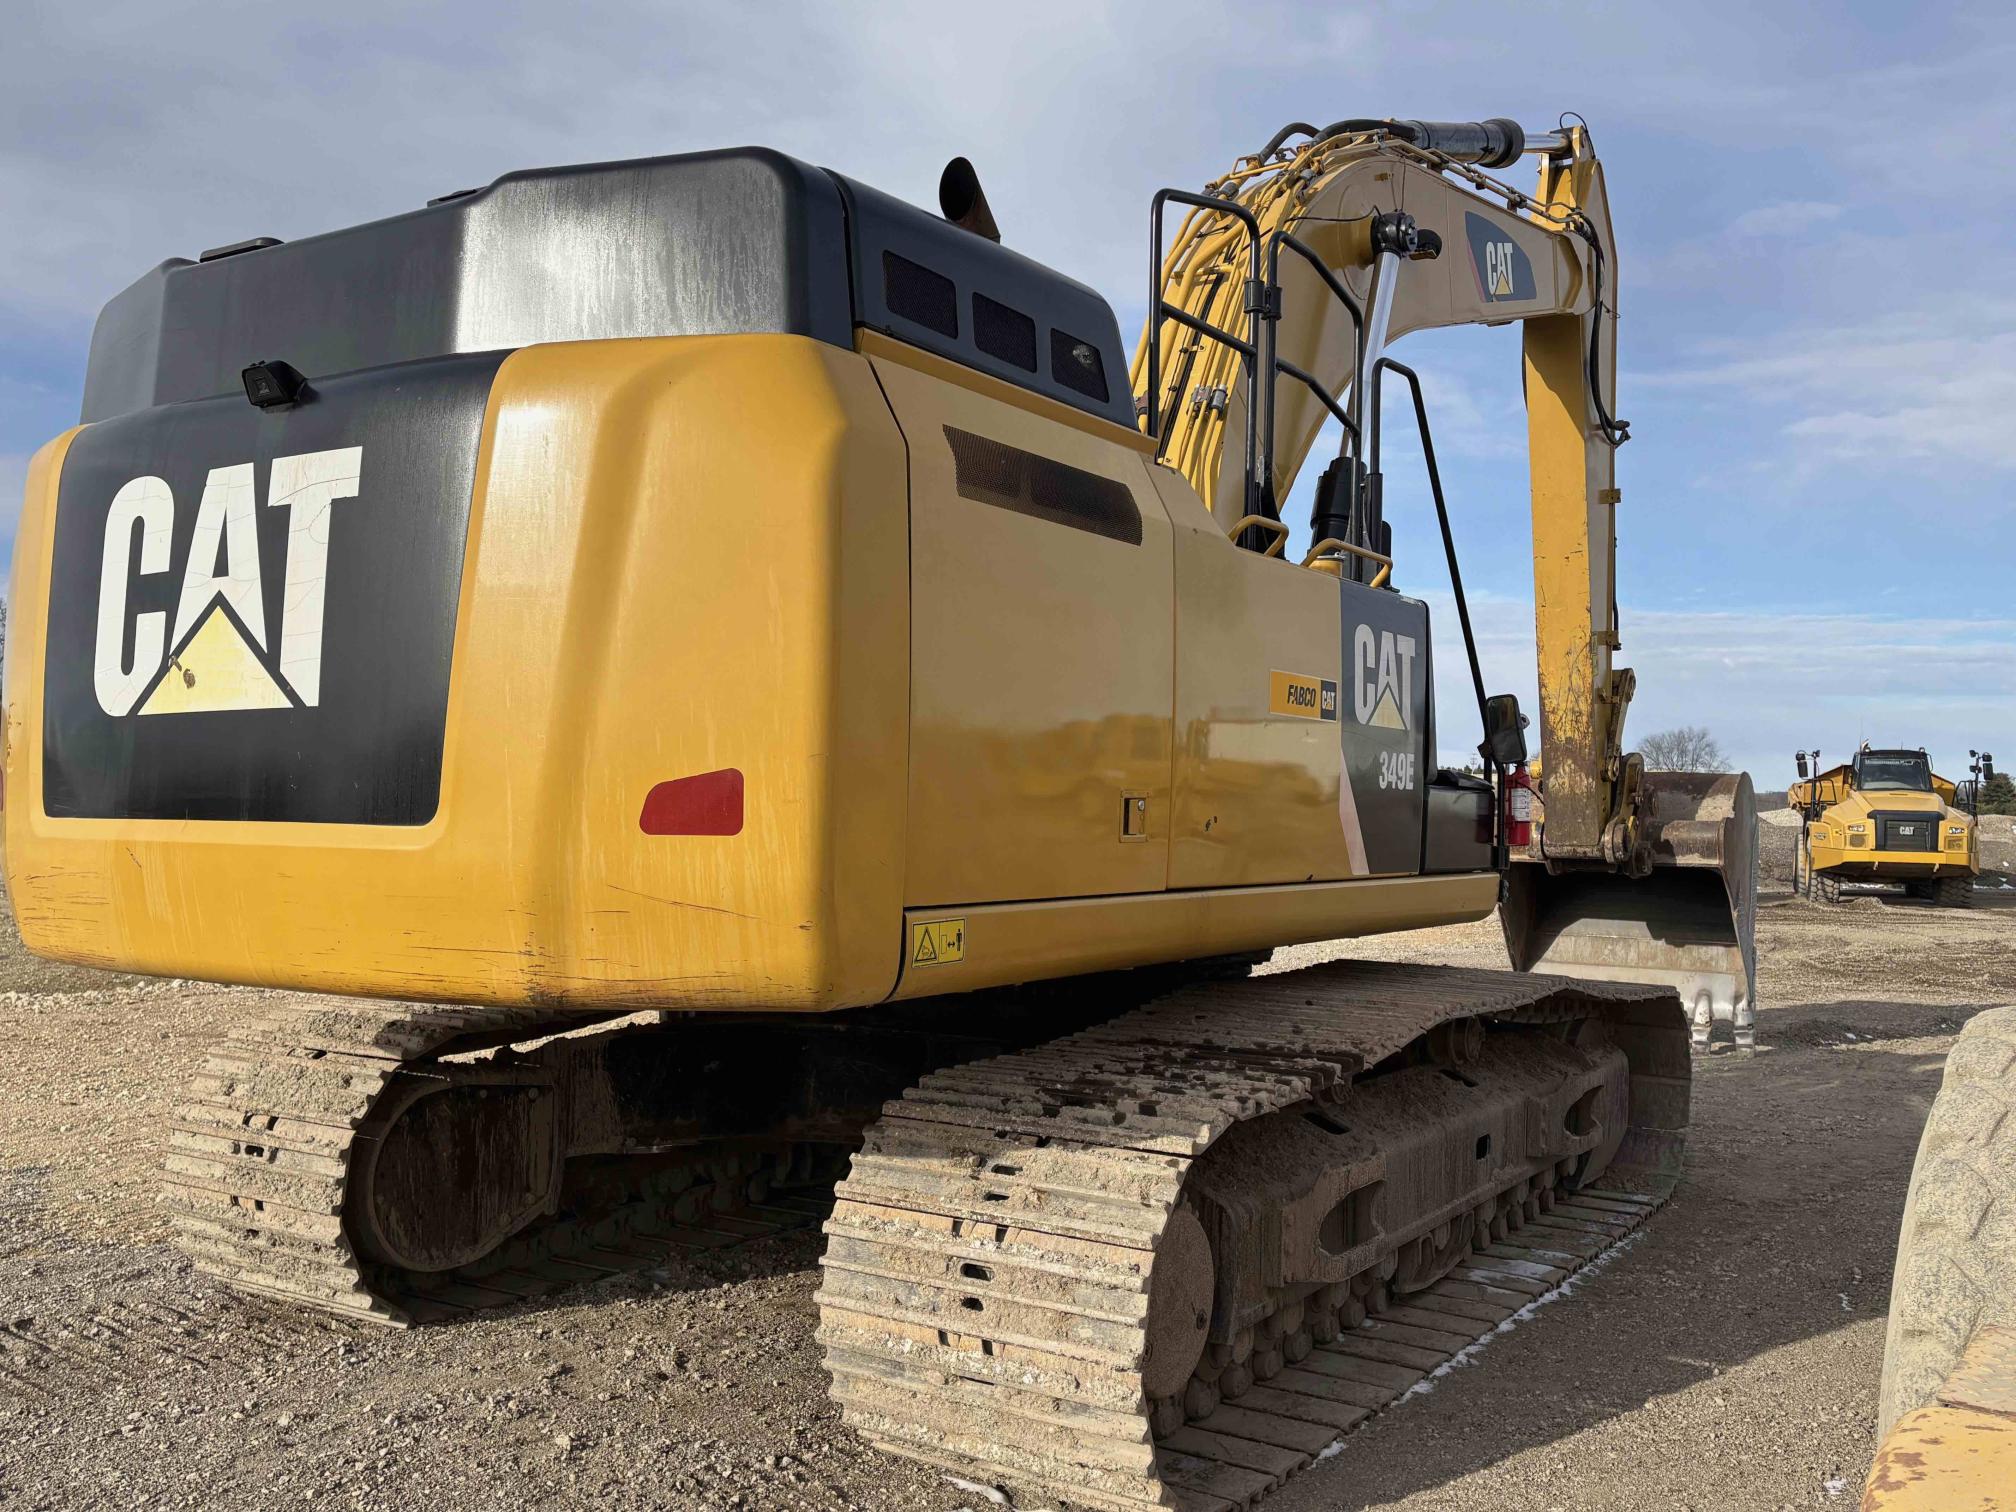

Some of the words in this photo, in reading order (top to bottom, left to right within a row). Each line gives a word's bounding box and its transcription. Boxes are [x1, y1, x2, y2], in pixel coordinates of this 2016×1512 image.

[1486, 241, 1513, 295] CAT
[94, 446, 363, 717] CAT
[1287, 684, 1316, 708] FABCO
[1322, 690, 1335, 710] CAT
[1354, 623, 1416, 730] CAT
[1379, 751, 1414, 790] 349E
[1899, 826, 1914, 835] CAT
